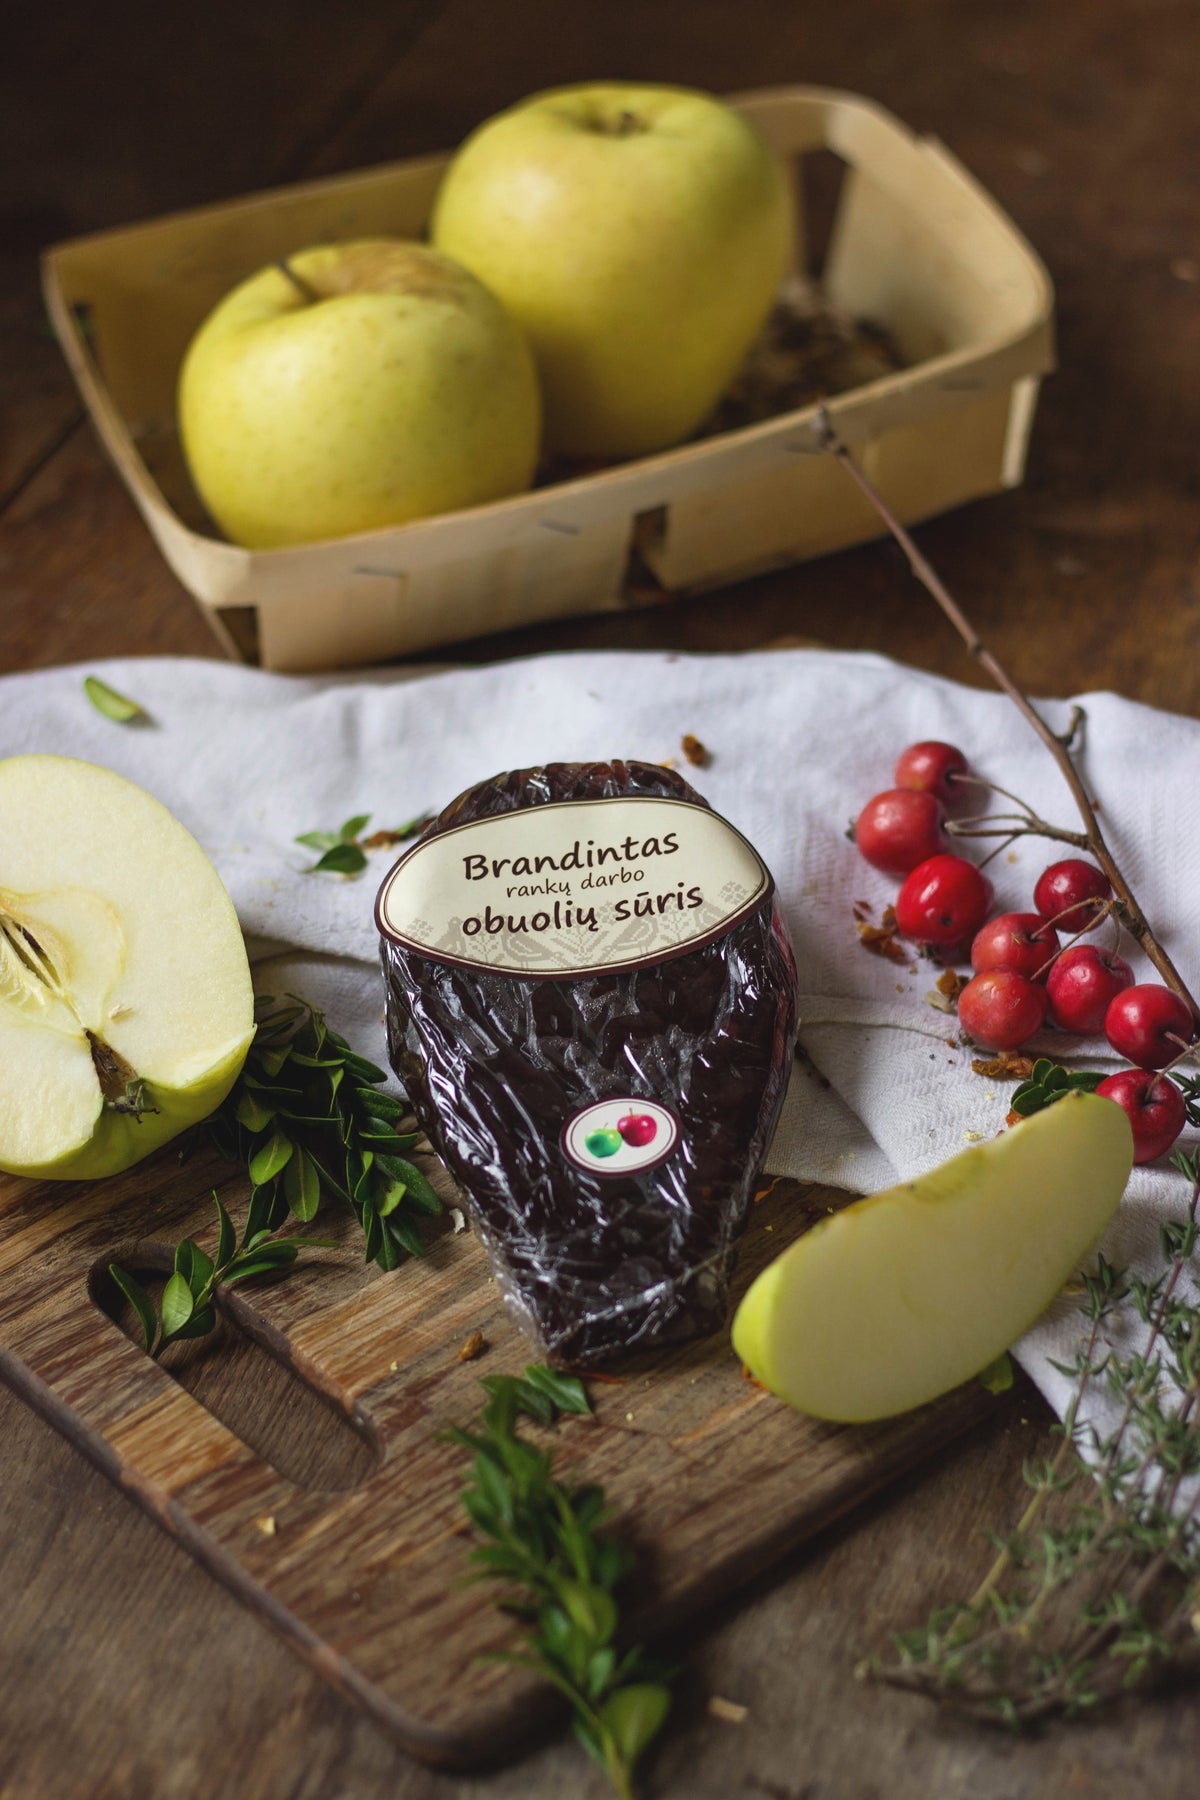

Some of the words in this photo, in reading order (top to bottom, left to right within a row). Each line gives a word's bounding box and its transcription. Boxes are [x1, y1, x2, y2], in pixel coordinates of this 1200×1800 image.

[462, 832, 680, 881] Brandintas
[506, 878, 572, 898] rankų
[580, 867, 645, 890] darbo
[462, 900, 599, 936] obuolių
[614, 882, 704, 921] sūris
